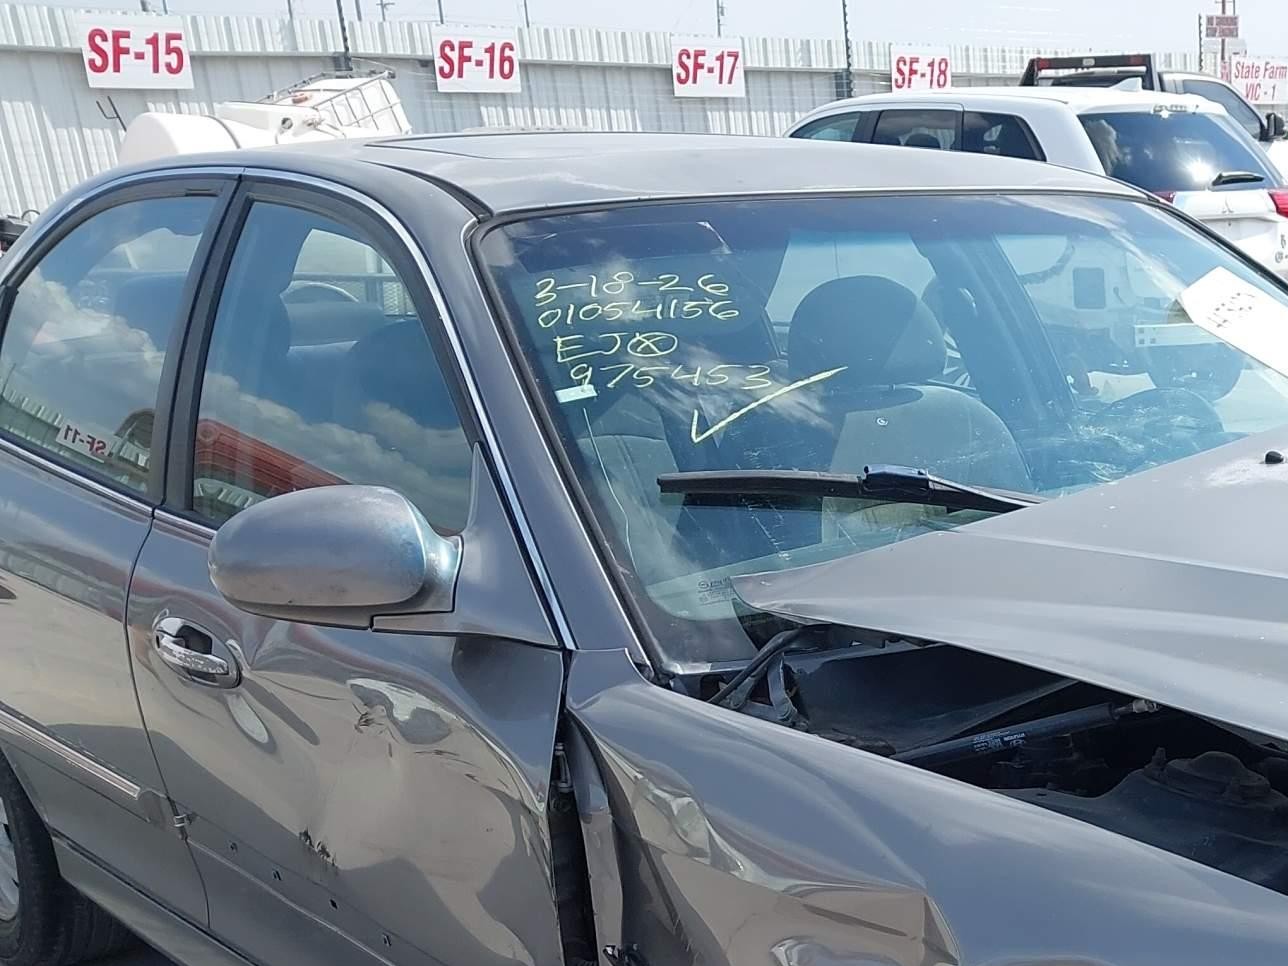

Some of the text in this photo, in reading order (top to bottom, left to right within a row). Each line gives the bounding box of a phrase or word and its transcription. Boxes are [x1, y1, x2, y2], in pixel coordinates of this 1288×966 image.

[88, 28, 184, 75] SF-15
[438, 39, 515, 80] SF-16
[676, 48, 739, 85] SF-17
[894, 56, 949, 89] SF-18
[1234, 61, 1260, 80] State
[1262, 61, 1288, 79] Farm
[1245, 83, 1262, 101] VIC
[1270, 83, 1276, 100] 1
[538, 298, 740, 328] 01054156
[570, 363, 773, 390] 975453
